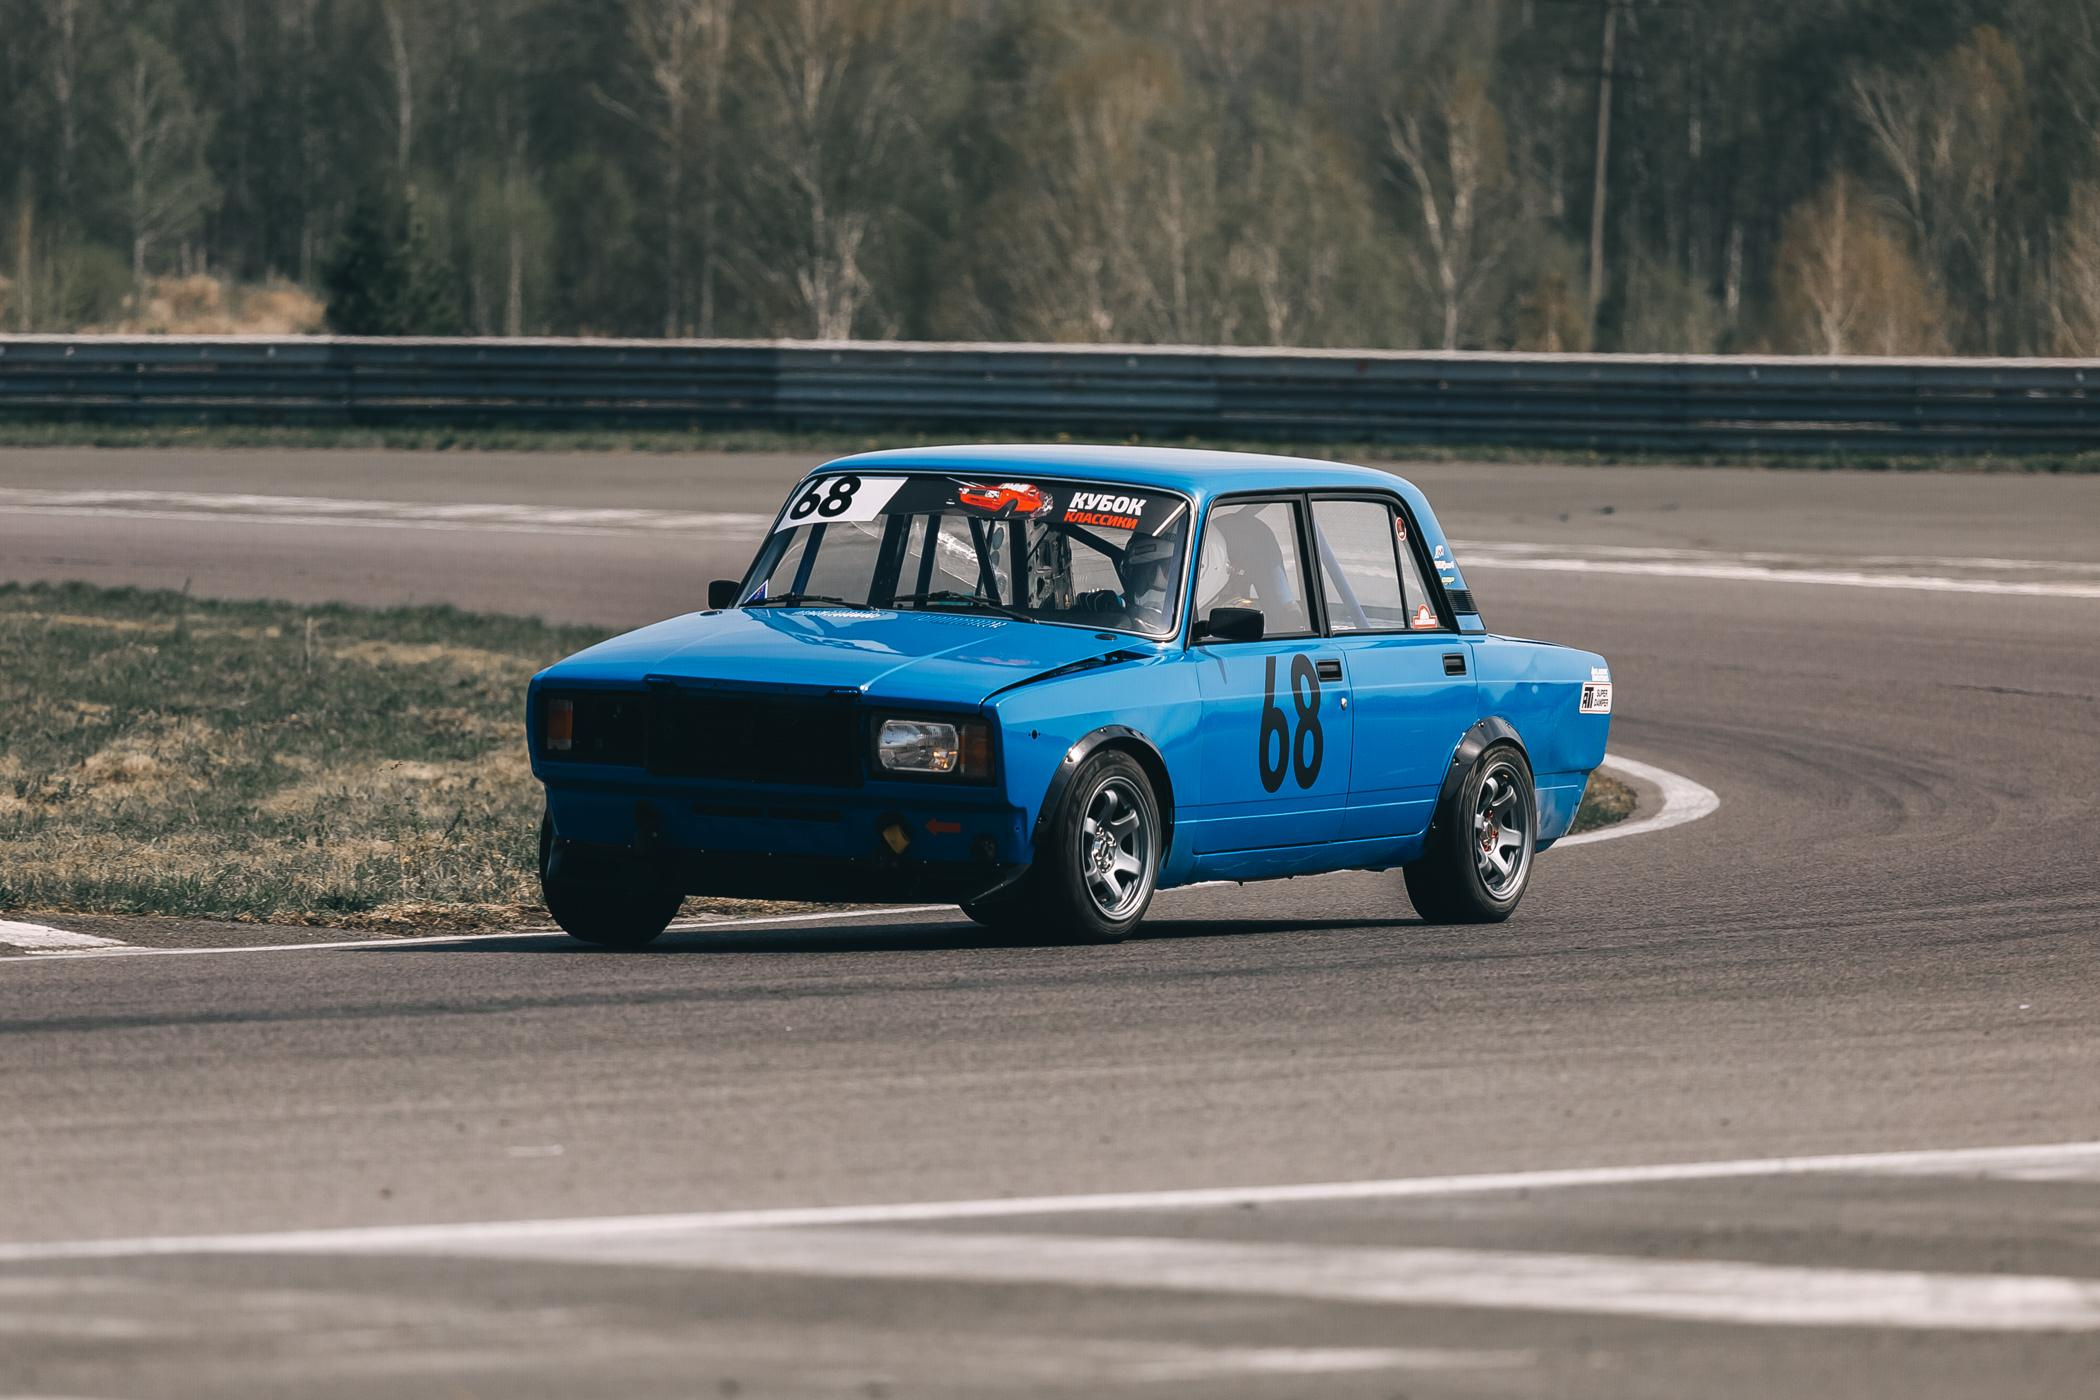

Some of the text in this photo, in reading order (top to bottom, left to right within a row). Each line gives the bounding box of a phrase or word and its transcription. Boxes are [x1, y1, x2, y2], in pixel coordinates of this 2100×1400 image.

[790, 476, 861, 520] 68
[1069, 492, 1147, 516] КУБОК
[1064, 511, 1138, 530] КЛАССИКИ
[1259, 654, 1323, 793] 68
